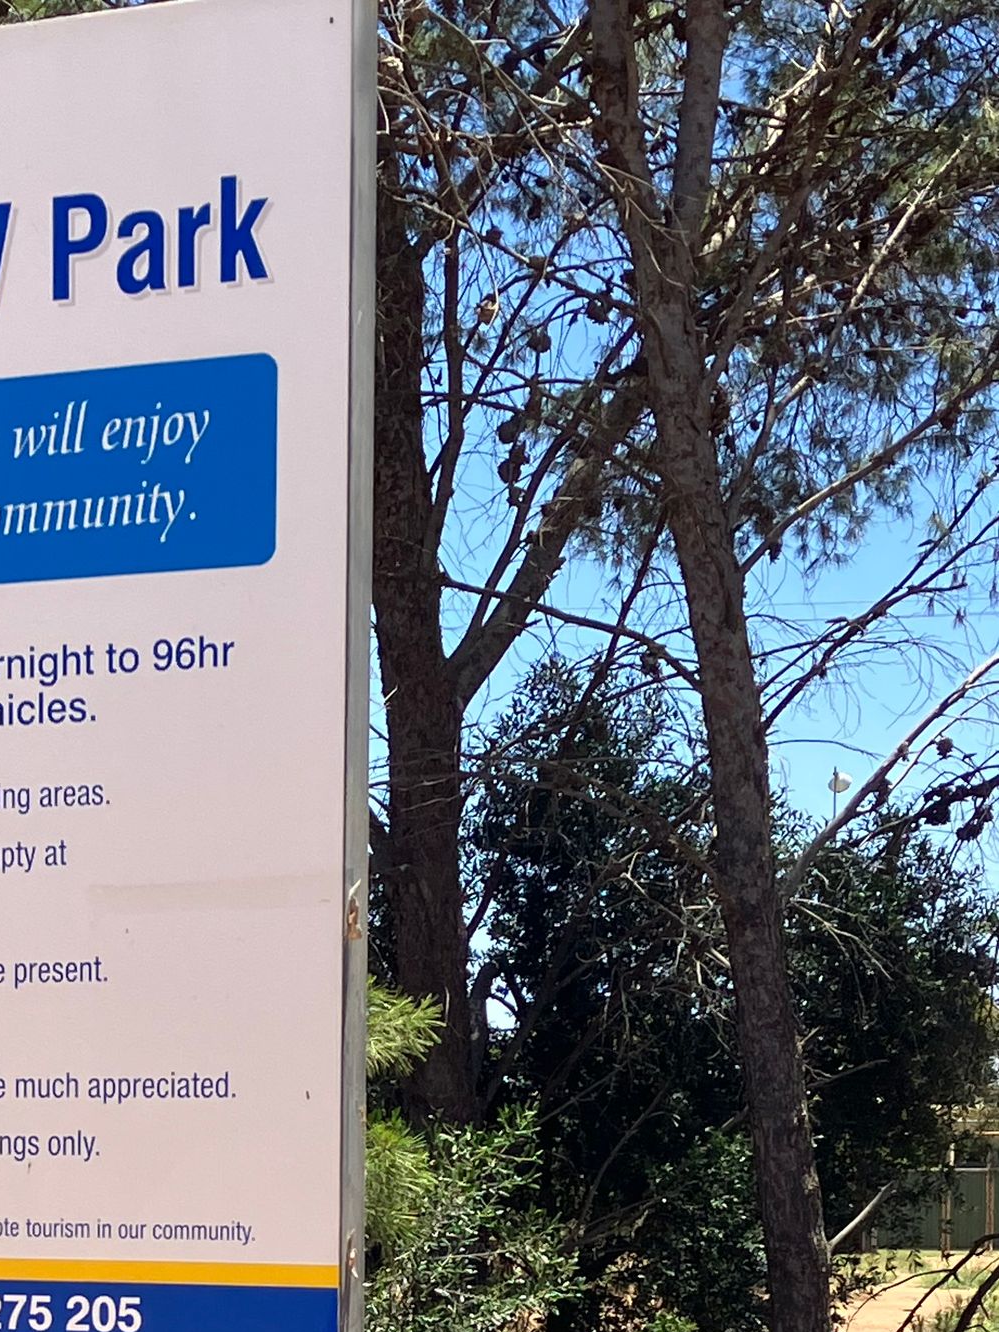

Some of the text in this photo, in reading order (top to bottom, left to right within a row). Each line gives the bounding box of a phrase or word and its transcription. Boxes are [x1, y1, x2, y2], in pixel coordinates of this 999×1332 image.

[53, 176, 268, 300] Park
[14, 401, 87, 458] will
[102, 402, 209, 464] enjoy
[106, 643, 139, 674] to
[153, 635, 234, 671] 96hr
[40, 785, 110, 807] areas.
[26, 1218, 90, 1238] tourism
[97, 1219, 112, 1239] in
[118, 1224, 147, 1239] our
[153, 1221, 255, 1246] community.
[66, 1296, 141, 1332] 205
